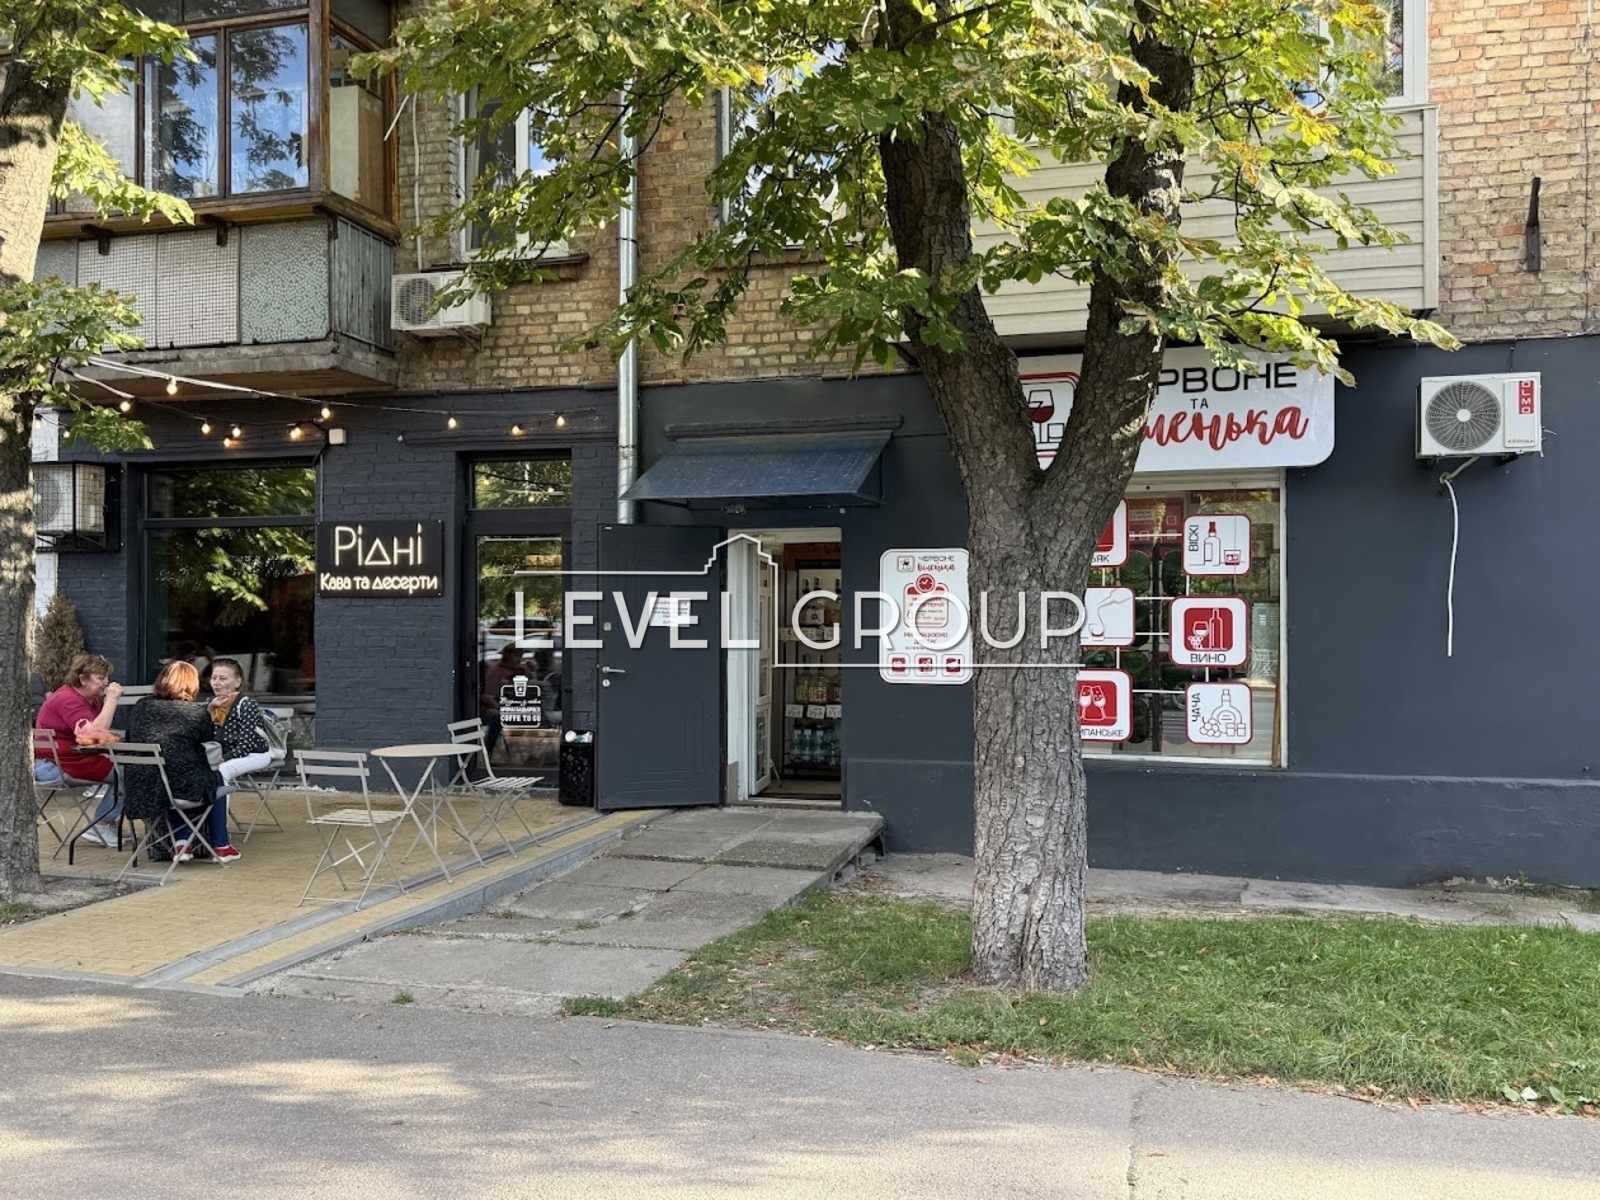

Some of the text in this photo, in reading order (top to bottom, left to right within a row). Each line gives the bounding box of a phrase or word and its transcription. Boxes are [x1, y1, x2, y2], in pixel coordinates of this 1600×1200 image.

[1155, 362, 1297, 395] РВОНЕ
[1190, 398, 1209, 410] ТА
[1142, 406, 1309, 451] ленька
[320, 572, 438, 594] Кава та десерти
[1190, 653, 1227, 663] ВИНО
[1191, 692, 1201, 722] ЧАЧА
